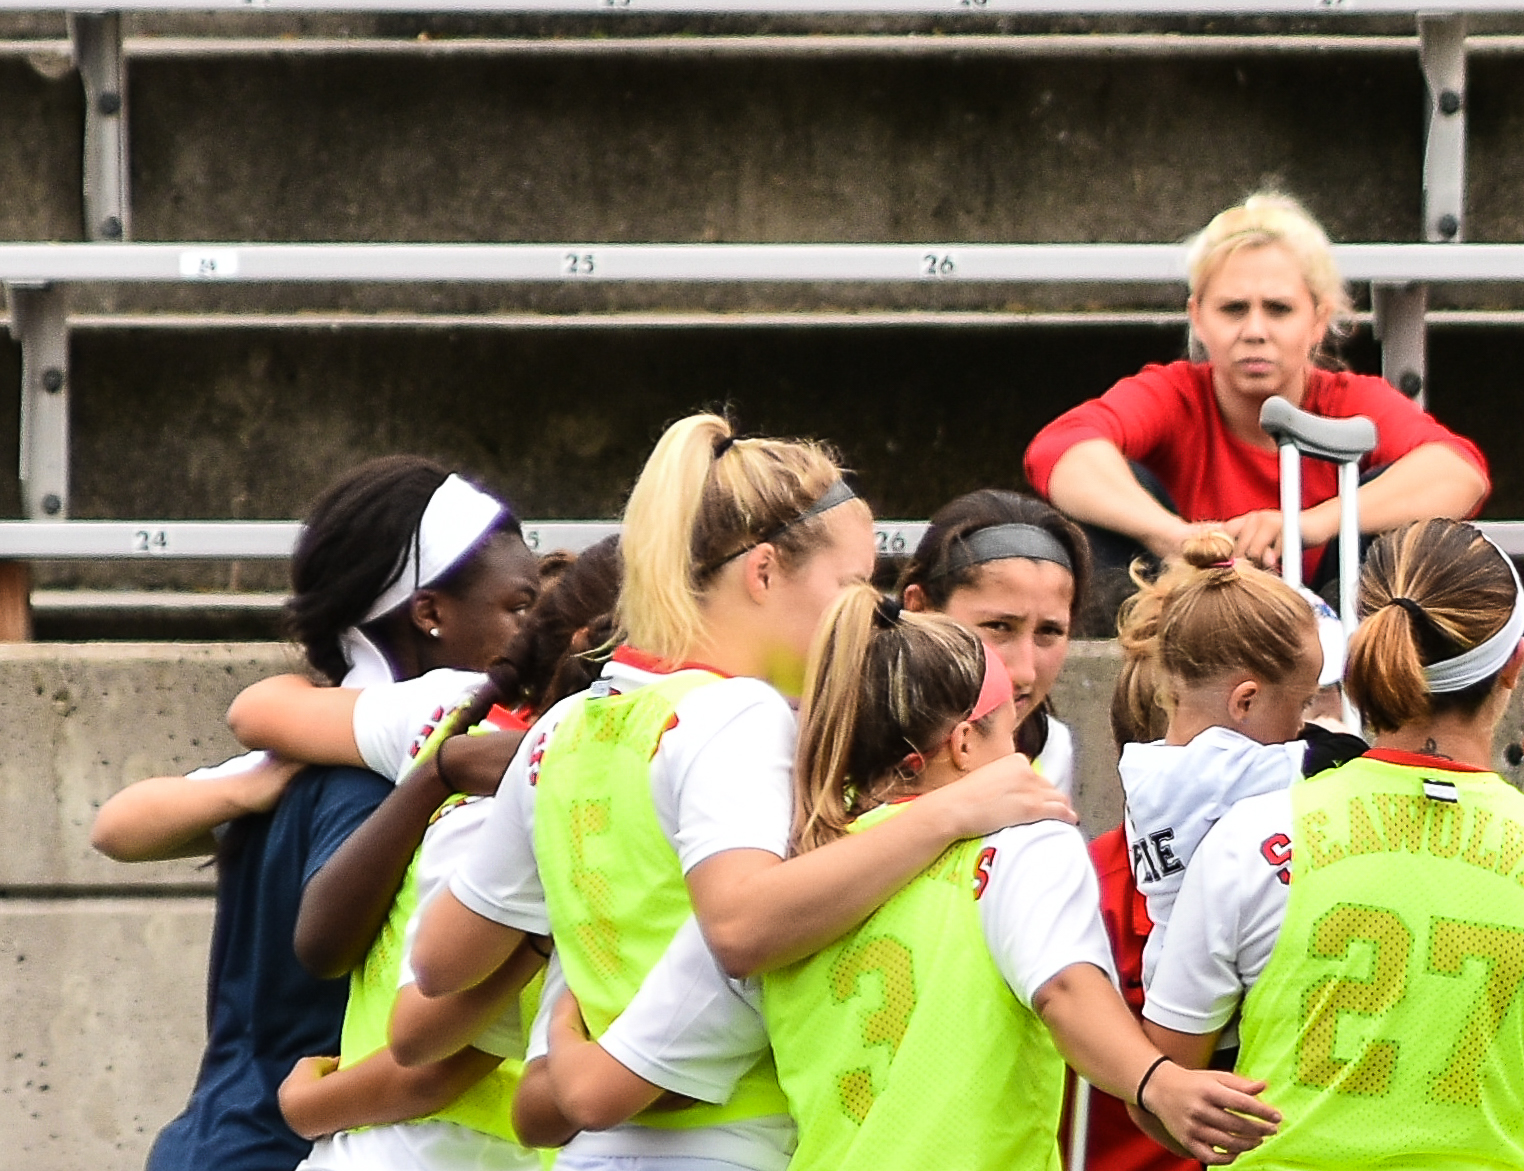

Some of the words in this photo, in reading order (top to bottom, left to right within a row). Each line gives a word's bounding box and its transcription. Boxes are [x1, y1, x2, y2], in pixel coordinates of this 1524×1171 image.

[565, 253, 595, 275] 25
[924, 253, 954, 275] 26
[135, 530, 166, 551] 24
[526, 530, 540, 551] 5
[875, 530, 905, 551] 26
[826, 933, 916, 1128] 3
